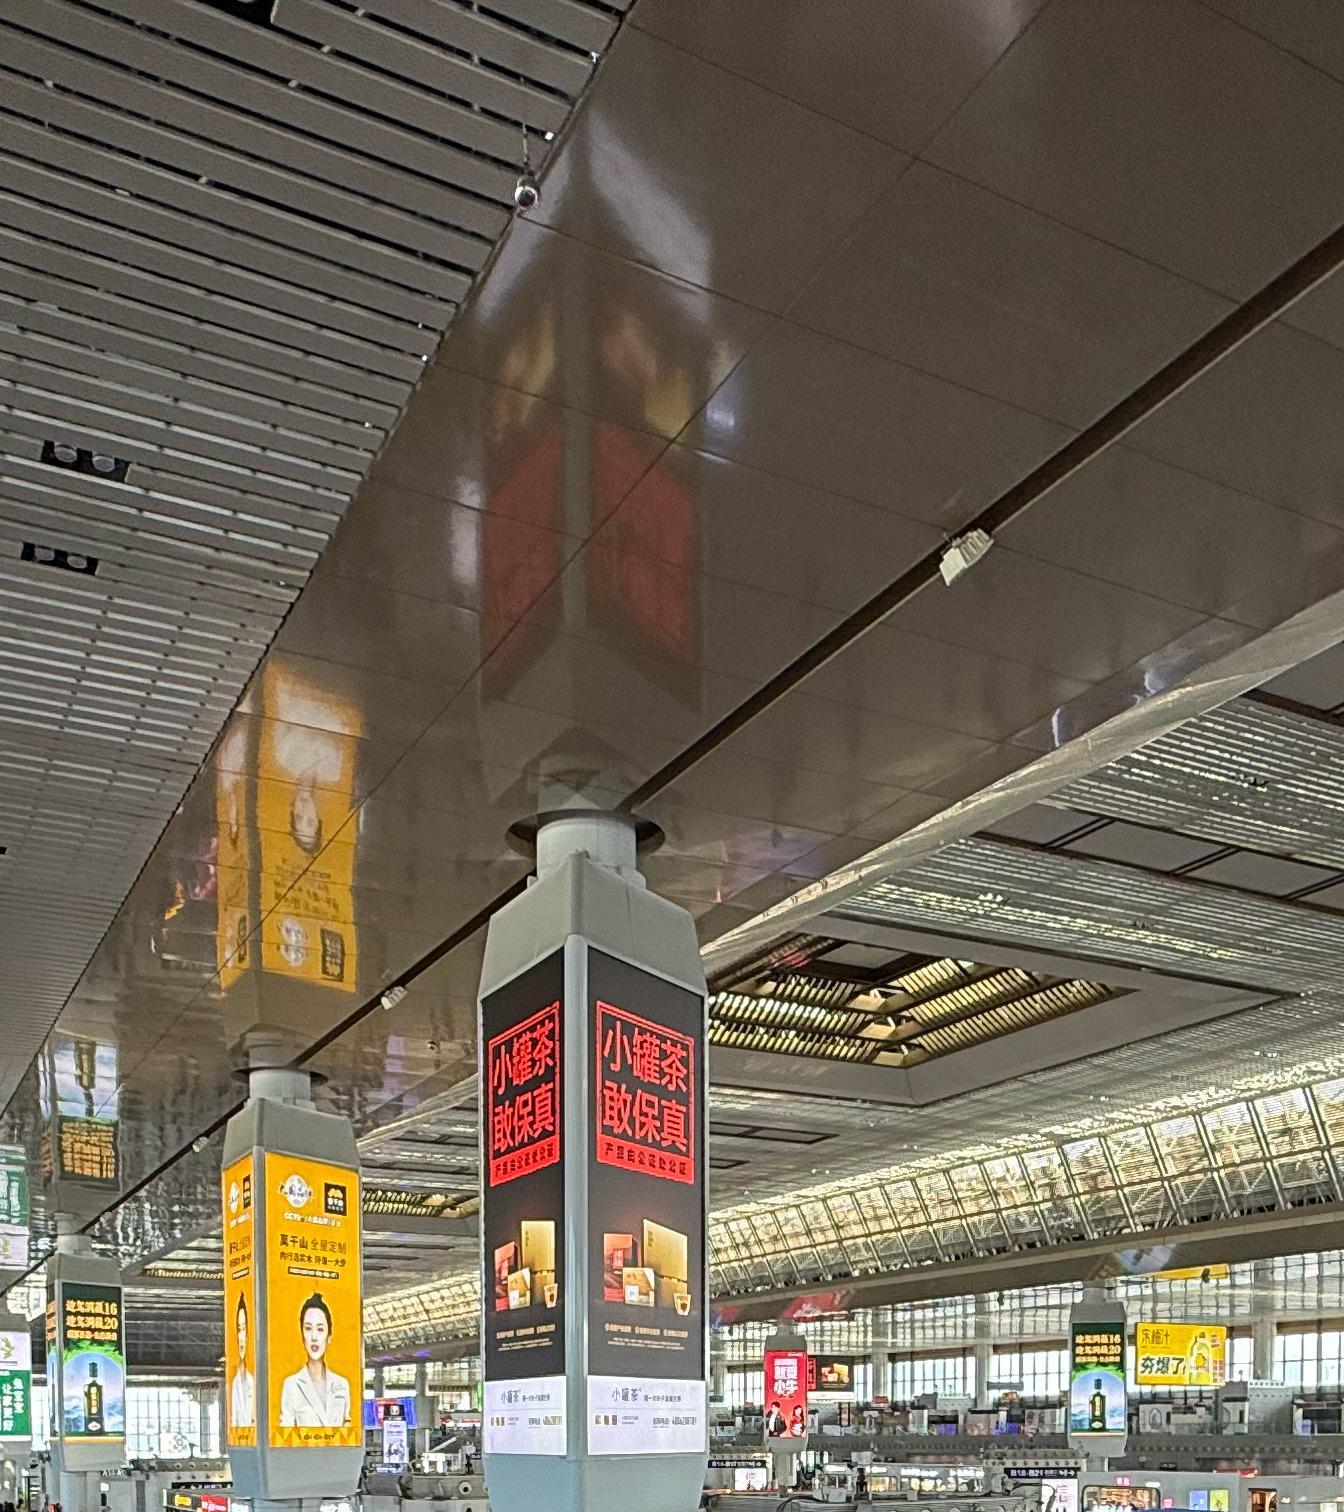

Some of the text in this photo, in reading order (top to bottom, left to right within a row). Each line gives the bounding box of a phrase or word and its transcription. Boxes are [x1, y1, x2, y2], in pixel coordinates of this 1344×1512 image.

[494, 1019, 553, 1095] 小罐茶
[604, 1020, 687, 1093] 小罐茶
[494, 1082, 553, 1152] 敢保真
[603, 1080, 687, 1152] 敢保真
[280, 1233, 308, 1249] 莫干山
[1140, 1356, 1185, 1375] 夯爆了
